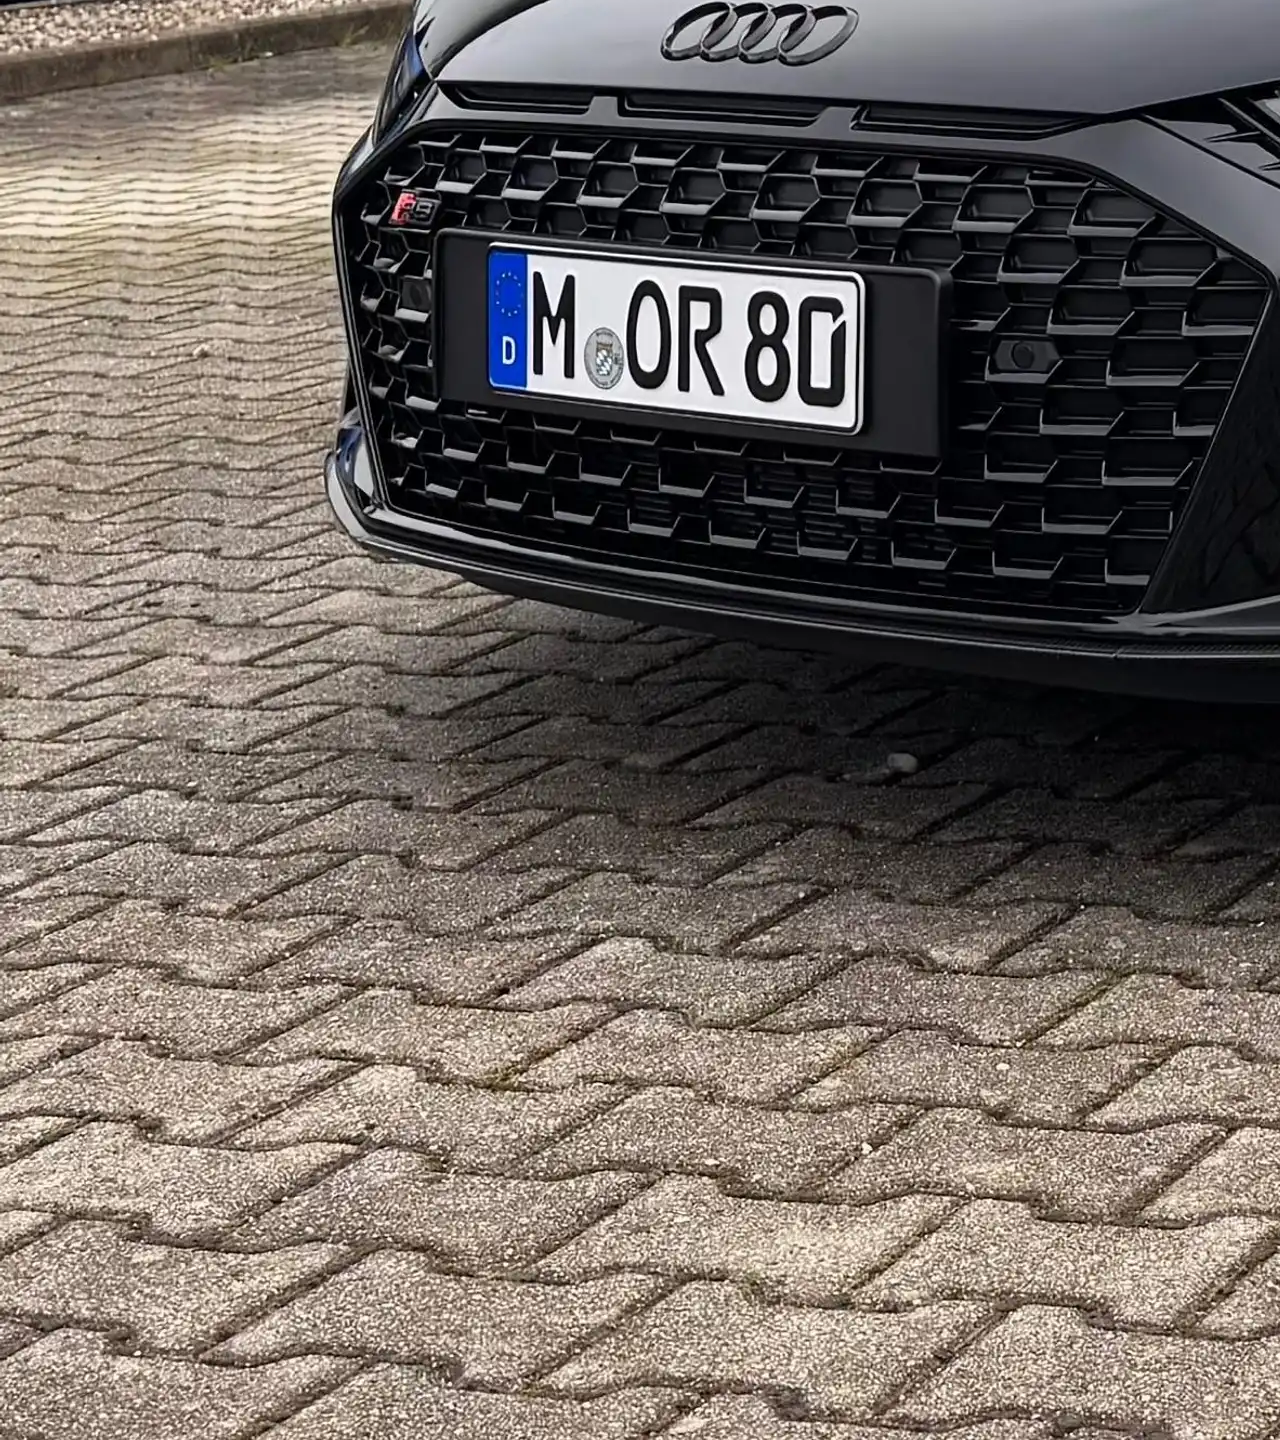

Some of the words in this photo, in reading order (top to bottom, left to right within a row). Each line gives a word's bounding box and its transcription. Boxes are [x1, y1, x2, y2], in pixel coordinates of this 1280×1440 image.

[502, 336, 516, 365] D
[532, 270, 576, 379] M
[626, 279, 725, 397] OR
[744, 291, 846, 408] 80
